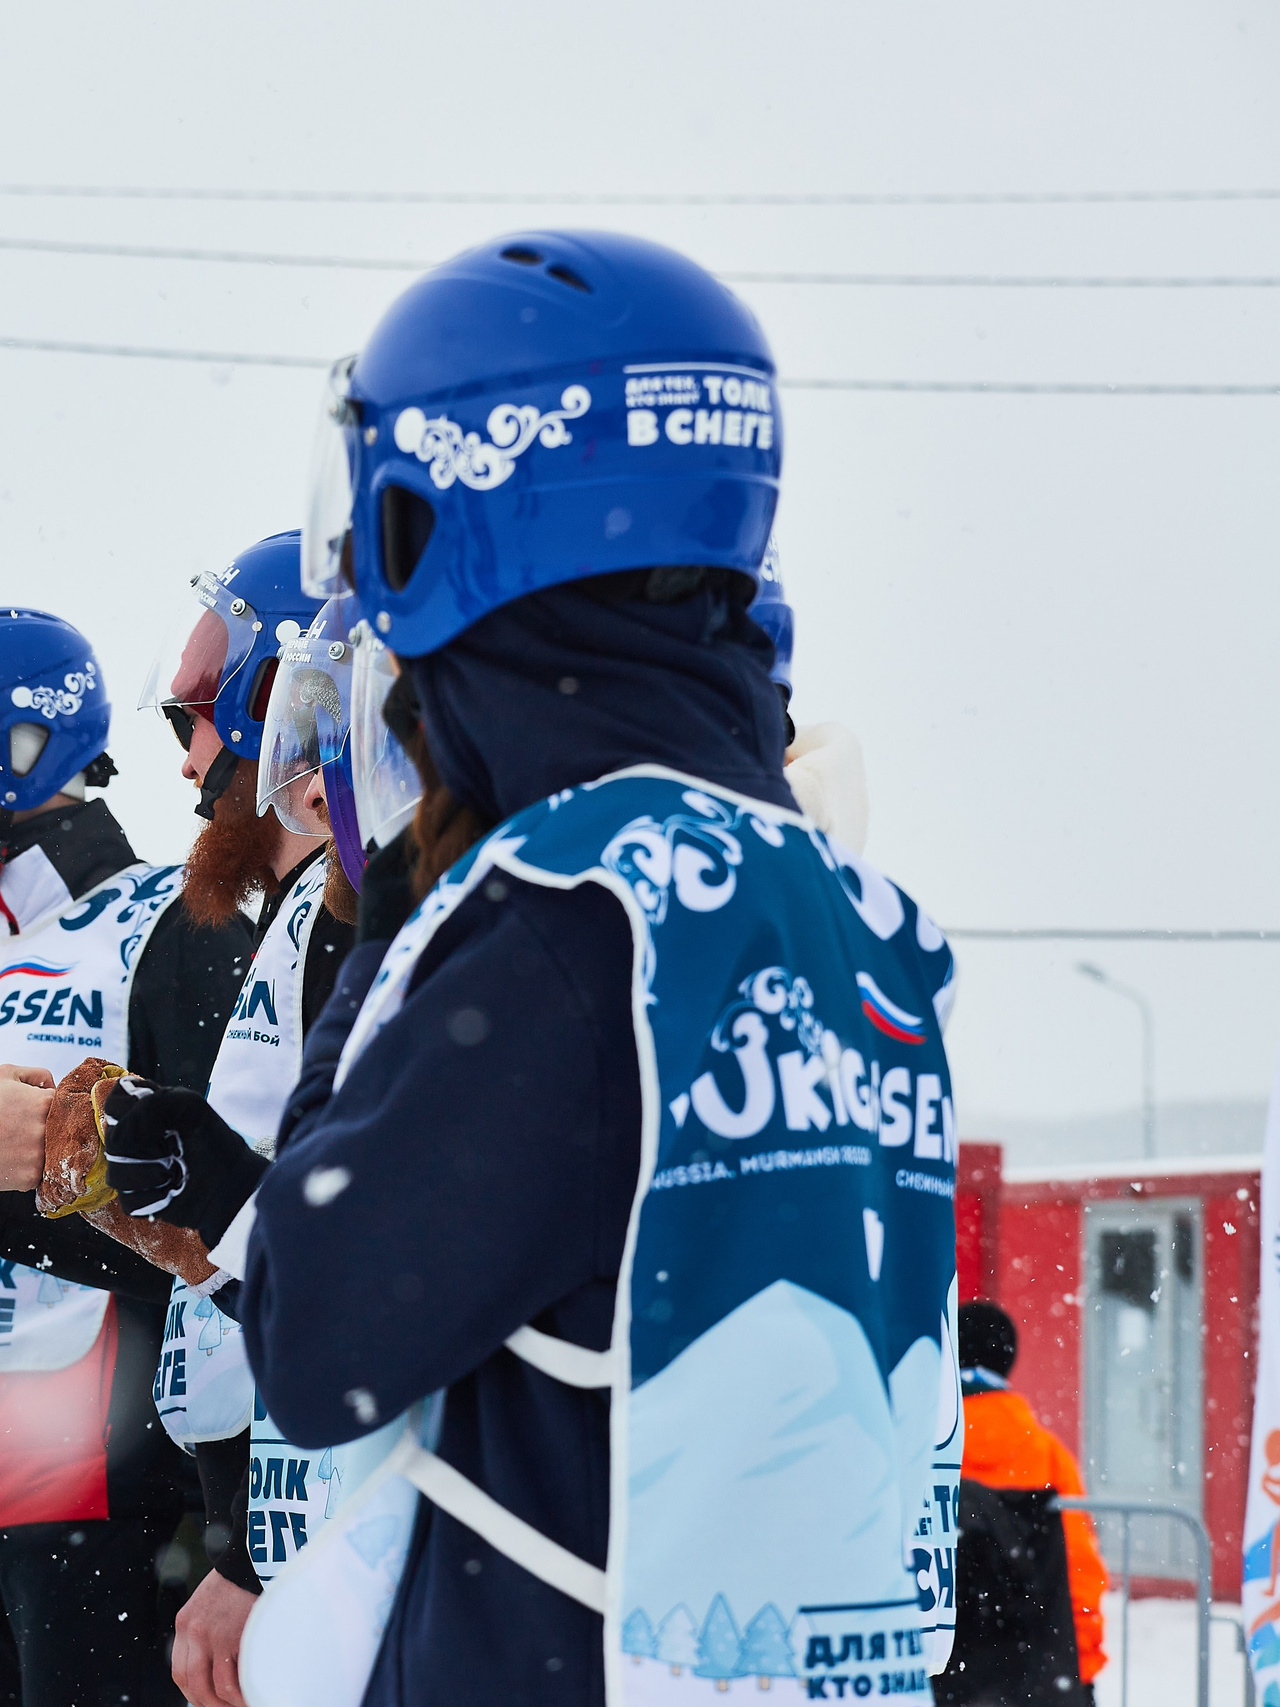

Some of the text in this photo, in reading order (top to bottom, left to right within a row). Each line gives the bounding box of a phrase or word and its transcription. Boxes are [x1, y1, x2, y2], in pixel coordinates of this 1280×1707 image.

[627, 408, 774, 450] В СНЕГЕ
[253, 1031, 280, 1047] БОЙ
[912, 1547, 958, 1613] СН
[806, 1632, 885, 1669] ДЛЯ
[807, 1674, 872, 1699] КТО
